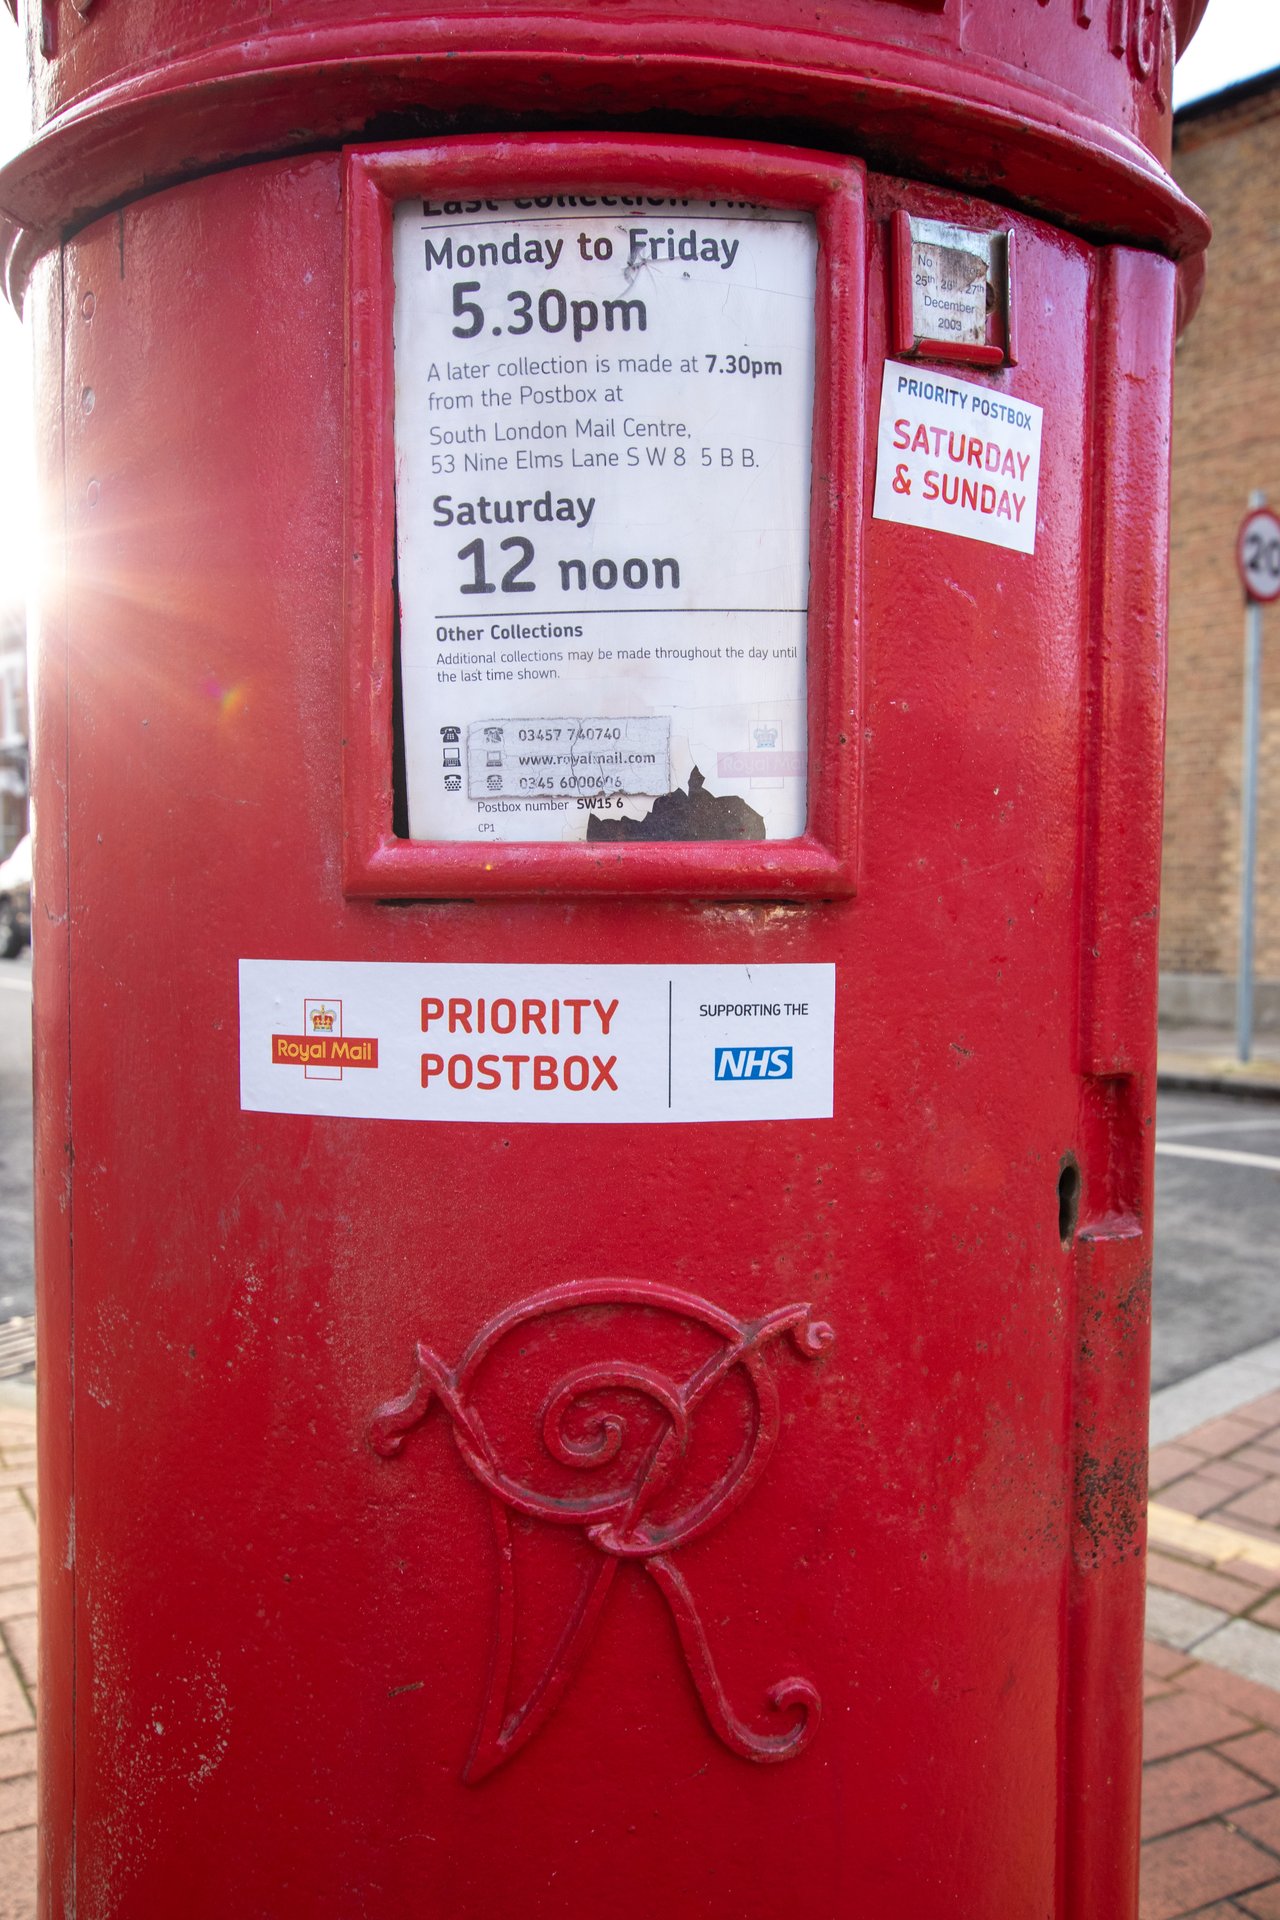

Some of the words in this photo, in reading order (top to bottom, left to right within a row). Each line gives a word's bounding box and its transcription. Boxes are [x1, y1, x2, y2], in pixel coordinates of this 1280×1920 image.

[424, 232, 563, 271] Monday
[577, 233, 612, 261] to
[628, 227, 741, 270] Friday
[917, 254, 933, 268] No
[452, 281, 648, 342] 5.30pm
[924, 295, 976, 314] December
[938, 317, 962, 332] 2003
[428, 363, 440, 382] A
[447, 362, 490, 380] later
[498, 356, 587, 376] collection
[596, 355, 610, 373] is
[618, 354, 672, 372] made
[681, 356, 699, 373] at
[705, 355, 782, 378] 7.30pm
[428, 392, 473, 410] from
[481, 388, 511, 407] the
[520, 385, 597, 404] Postbox
[605, 385, 623, 402] at
[897, 377, 967, 409] PRIORITY
[972, 396, 1032, 431] POSTBOX
[430, 424, 486, 445] South
[495, 421, 566, 441] London
[576, 418, 615, 437] Mail
[624, 418, 691, 438] Centre,
[432, 454, 455, 474] 53
[465, 453, 508, 472] Nine
[517, 450, 563, 469] Elms
[572, 448, 618, 467] Lane
[893, 418, 1032, 483] SATURDAY
[892, 463, 912, 496] &
[922, 469, 1027, 524] SUNDAY
[433, 491, 595, 528] Saturday
[458, 536, 536, 594] 12
[558, 558, 680, 591] noon
[1244, 533, 1280, 578] 20
[437, 626, 484, 641] Other
[491, 623, 583, 639] Collections
[437, 651, 496, 664] Additional
[501, 650, 563, 662] collections
[568, 651, 593, 662] may
[598, 648, 612, 659] be
[617, 648, 650, 659] made
[655, 647, 721, 661] throughout
[726, 646, 744, 658] the
[749, 646, 768, 660] day
[772, 646, 798, 659] until
[438, 671, 456, 682] the
[461, 669, 482, 681] last
[487, 669, 513, 680] time
[518, 668, 559, 679] shown.
[518, 728, 562, 743] 03457
[567, 727, 622, 741] 740740
[518, 751, 656, 767] www.royalmail.com
[519, 776, 554, 790] 0345
[477, 801, 521, 813] Postbox
[525, 801, 569, 811] number
[576, 797, 612, 810] SW15
[616, 797, 624, 809] 6
[478, 824, 494, 832] CP1
[419, 997, 620, 1036] PRIORITY
[700, 1004, 780, 1016] SUPPORTING
[784, 1003, 808, 1015] THE
[277, 1038, 328, 1062] Royal
[330, 1040, 372, 1062] Mail
[419, 1053, 619, 1092] POSTBOX
[716, 1050, 789, 1078] NHS
